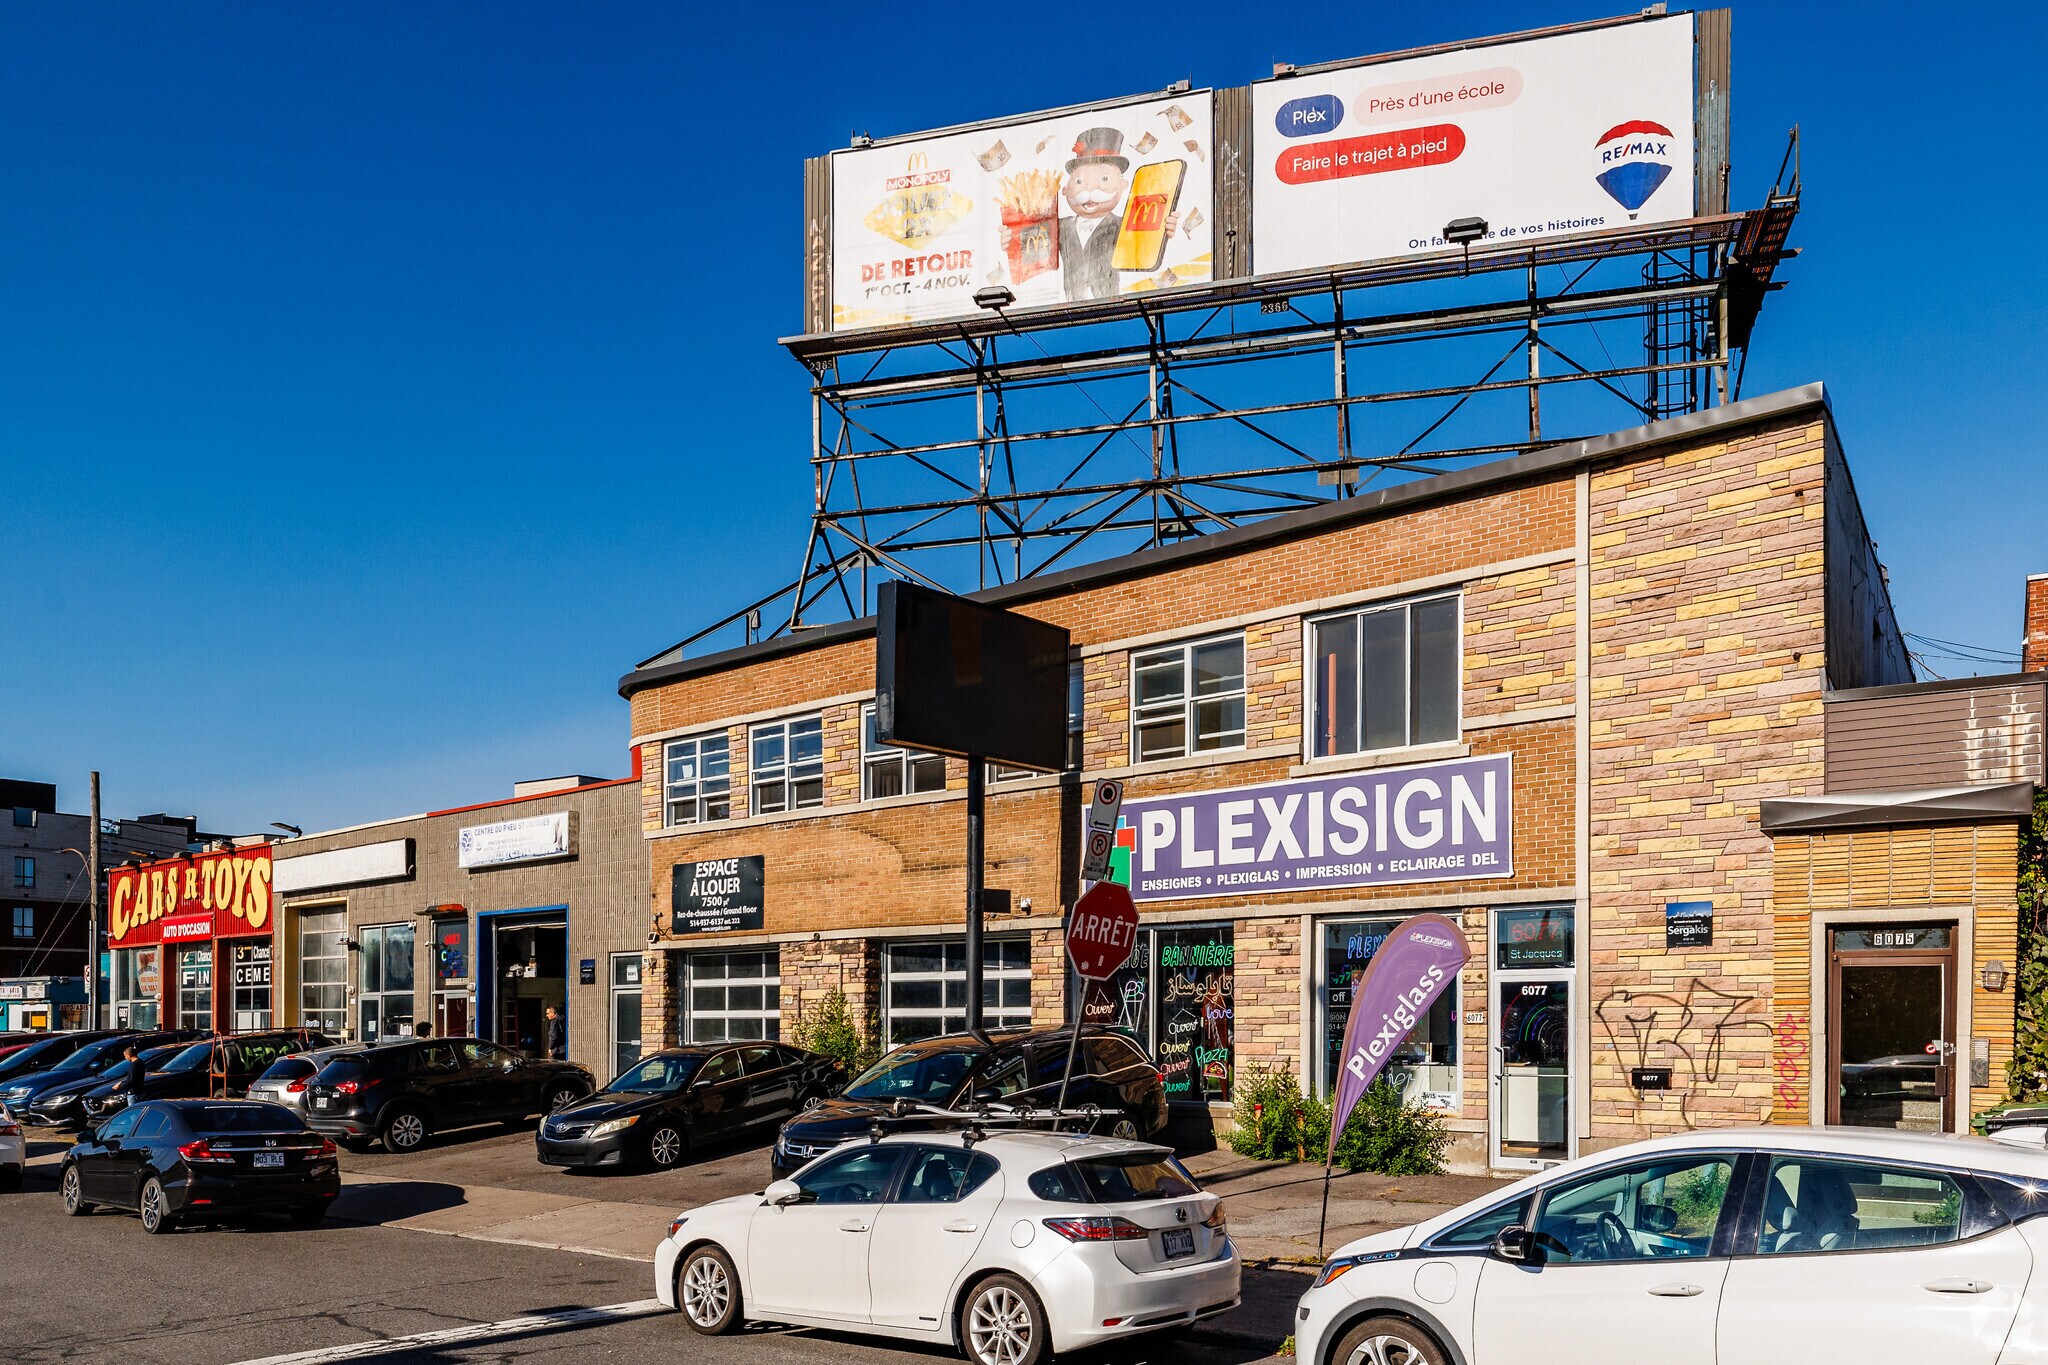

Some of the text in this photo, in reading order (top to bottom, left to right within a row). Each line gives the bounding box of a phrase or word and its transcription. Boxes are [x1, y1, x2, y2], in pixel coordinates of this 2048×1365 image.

[1370, 82, 1504, 113] Près d'une école
[1292, 110, 1326, 125] Plex
[1293, 137, 1447, 172] Faire le trajet à pied
[1602, 142, 1666, 164] RE/MAX
[887, 170, 950, 189] MONOPOLY
[1409, 239, 1427, 248] On
[1500, 227, 1516, 238] de
[1521, 224, 1544, 235] vos
[1548, 216, 1605, 231] histoires
[861, 249, 973, 283] DE RETOUR
[865, 286, 878, 299] 1er
[881, 282, 911, 296] OCT.
[923, 279, 932, 290] 4
[935, 274, 970, 289] NOV.
[1261, 301, 1288, 314] 2366
[474, 826, 494, 836] CENTRE
[1142, 771, 1496, 872] PLEXISIGN
[695, 858, 739, 878] ESPACE
[1142, 852, 1499, 891] ENSEIGNES PLEXIGLAS IMPRESSION ECLAIRAGE DEL
[690, 877, 740, 896] À LOUER
[112, 857, 271, 940] CARS R TOYS
[701, 896, 722, 907] 7500
[723, 907, 742, 915] Ground
[163, 922, 210, 938] AUTO D'OCCASION
[1072, 913, 1134, 947] ARRÊT
[1512, 921, 1560, 941] 6077
[1668, 924, 1709, 936] Sergakis
[1875, 933, 1913, 944] 6075
[1162, 941, 1234, 967] BANNIÈRE
[1347, 934, 1387, 959] PLEX
[1510, 949, 1562, 960] St Jacques
[1332, 992, 1346, 1001] off
[1521, 985, 1548, 995] 6077
[1085, 1003, 1115, 1016] Ouvert
[1468, 1013, 1483, 1022] 6077
[1168, 1019, 1198, 1034] Ouvert
[1346, 963, 1446, 1081] Plexiglass
[1160, 1040, 1190, 1054] Ouvert
